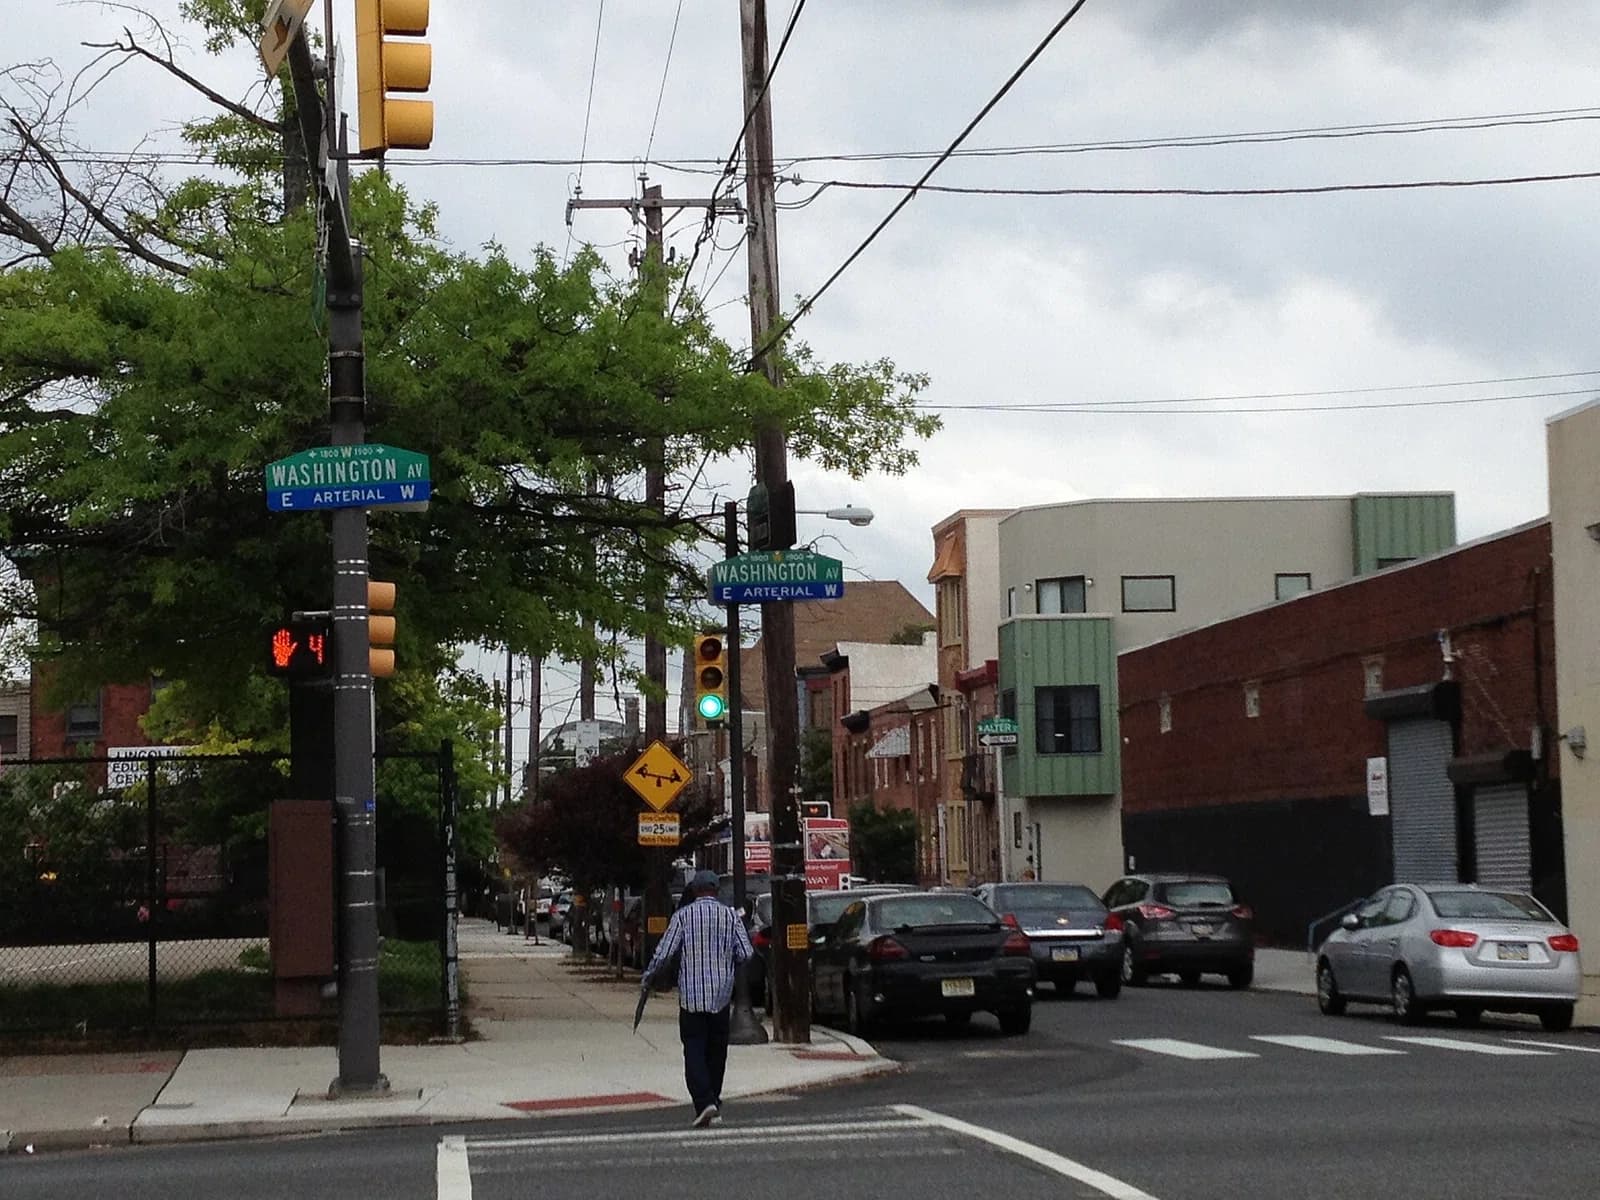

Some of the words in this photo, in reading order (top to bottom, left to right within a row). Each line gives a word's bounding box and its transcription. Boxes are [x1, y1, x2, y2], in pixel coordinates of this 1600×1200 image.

[341, 446, 352, 458] W
[272, 458, 396, 487] WASHINGTON
[407, 463, 423, 478] AV
[281, 492, 293, 507] E
[313, 489, 385, 504] ARTERIAL
[400, 484, 415, 499] W
[716, 562, 817, 583] WASHINGTON
[825, 567, 839, 580] AV
[722, 587, 732, 600] E
[743, 586, 814, 597] ARTERIAL
[825, 584, 837, 597] W
[309, 635, 323, 664] 4
[983, 723, 1011, 733] ALTER
[653, 823, 665, 835] 25
